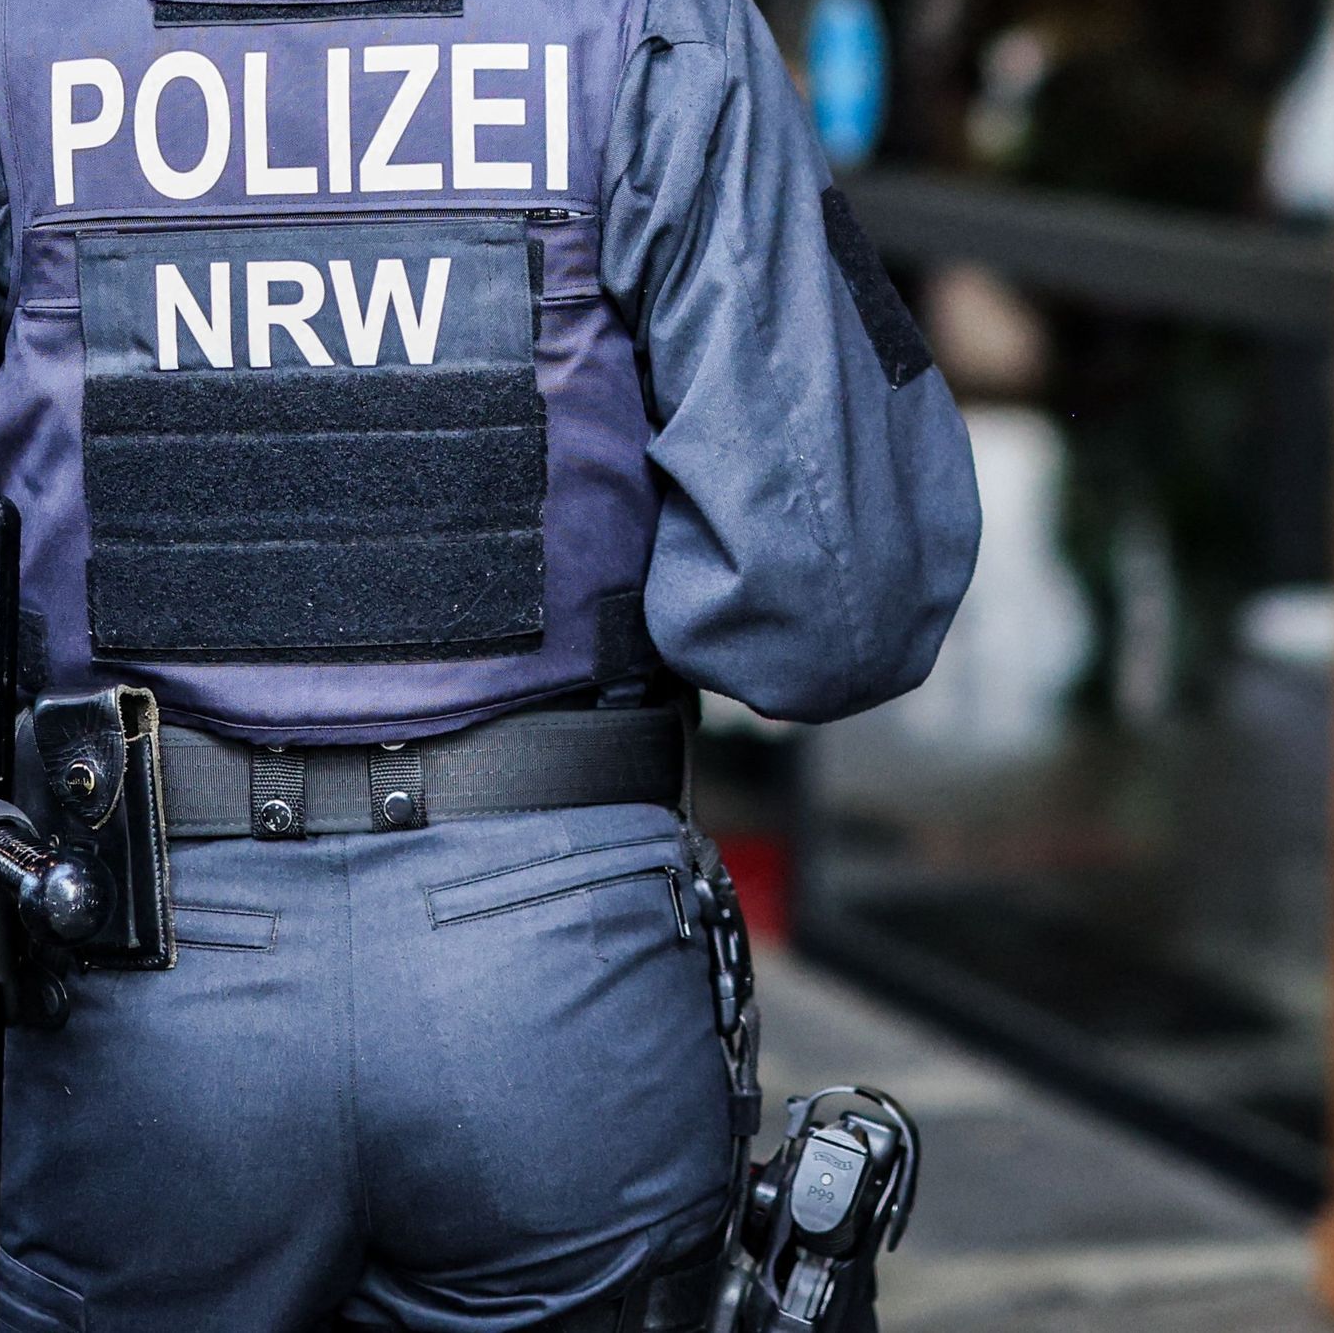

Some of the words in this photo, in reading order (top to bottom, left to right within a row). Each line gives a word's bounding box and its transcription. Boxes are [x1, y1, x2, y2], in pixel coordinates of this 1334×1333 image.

[51, 43, 569, 205] POLIZEI
[155, 257, 452, 370] NRW
[808, 1185, 835, 1204] P99
